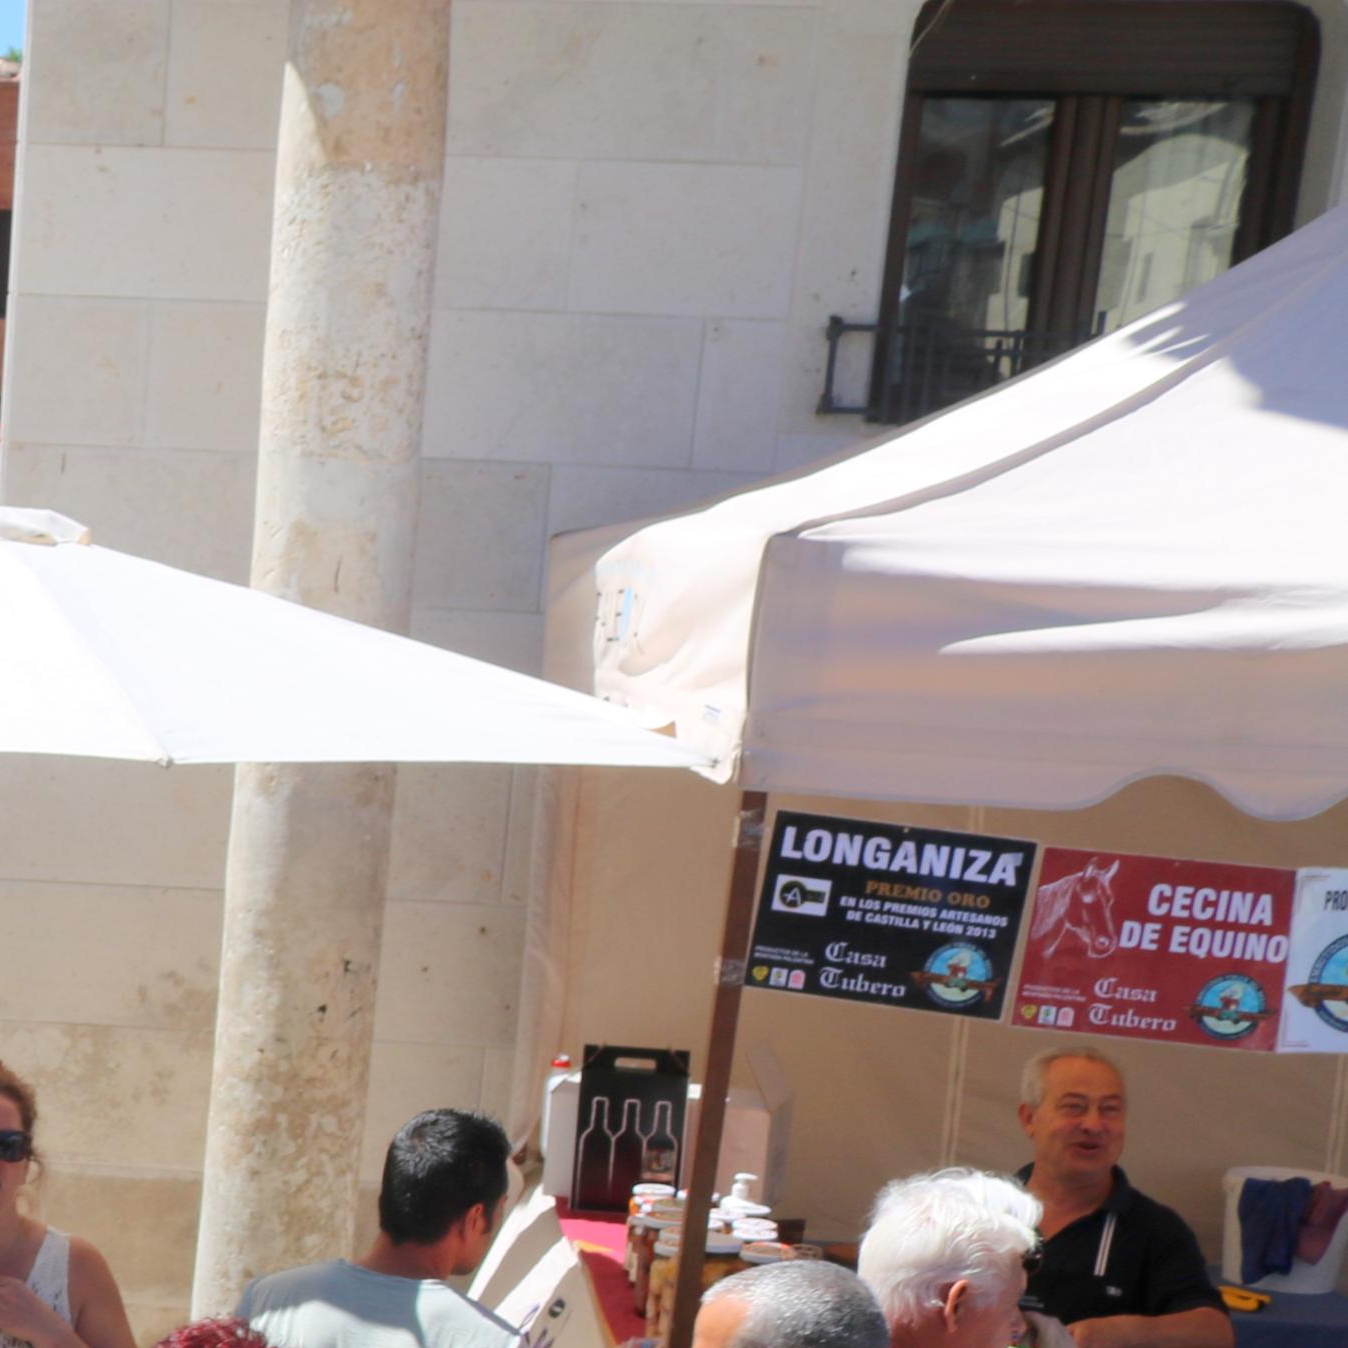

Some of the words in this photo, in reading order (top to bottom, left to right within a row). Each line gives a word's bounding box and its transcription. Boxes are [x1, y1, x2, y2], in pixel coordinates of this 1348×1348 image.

[780, 826, 1018, 887] LONGANIZA
[864, 880, 943, 904] PREMIO
[947, 891, 991, 909] ORO
[1147, 882, 1274, 926] CECINA
[839, 895, 856, 907] EN
[858, 897, 882, 912] LOS
[883, 900, 937, 919] PREMIOS
[939, 908, 1009, 928] ARTESANOS
[846, 910, 862, 922] DE
[865, 912, 920, 930] CASTILLA
[922, 919, 931, 931] Y
[966, 925, 997, 940] 2013
[824, 941, 888, 969] Casa
[1119, 920, 1159, 950] DE
[1168, 925, 1290, 964] EQUINO
[819, 966, 906, 998] Tubero
[1093, 977, 1158, 1003] Casa
[1088, 1002, 1177, 1032] Tubero
